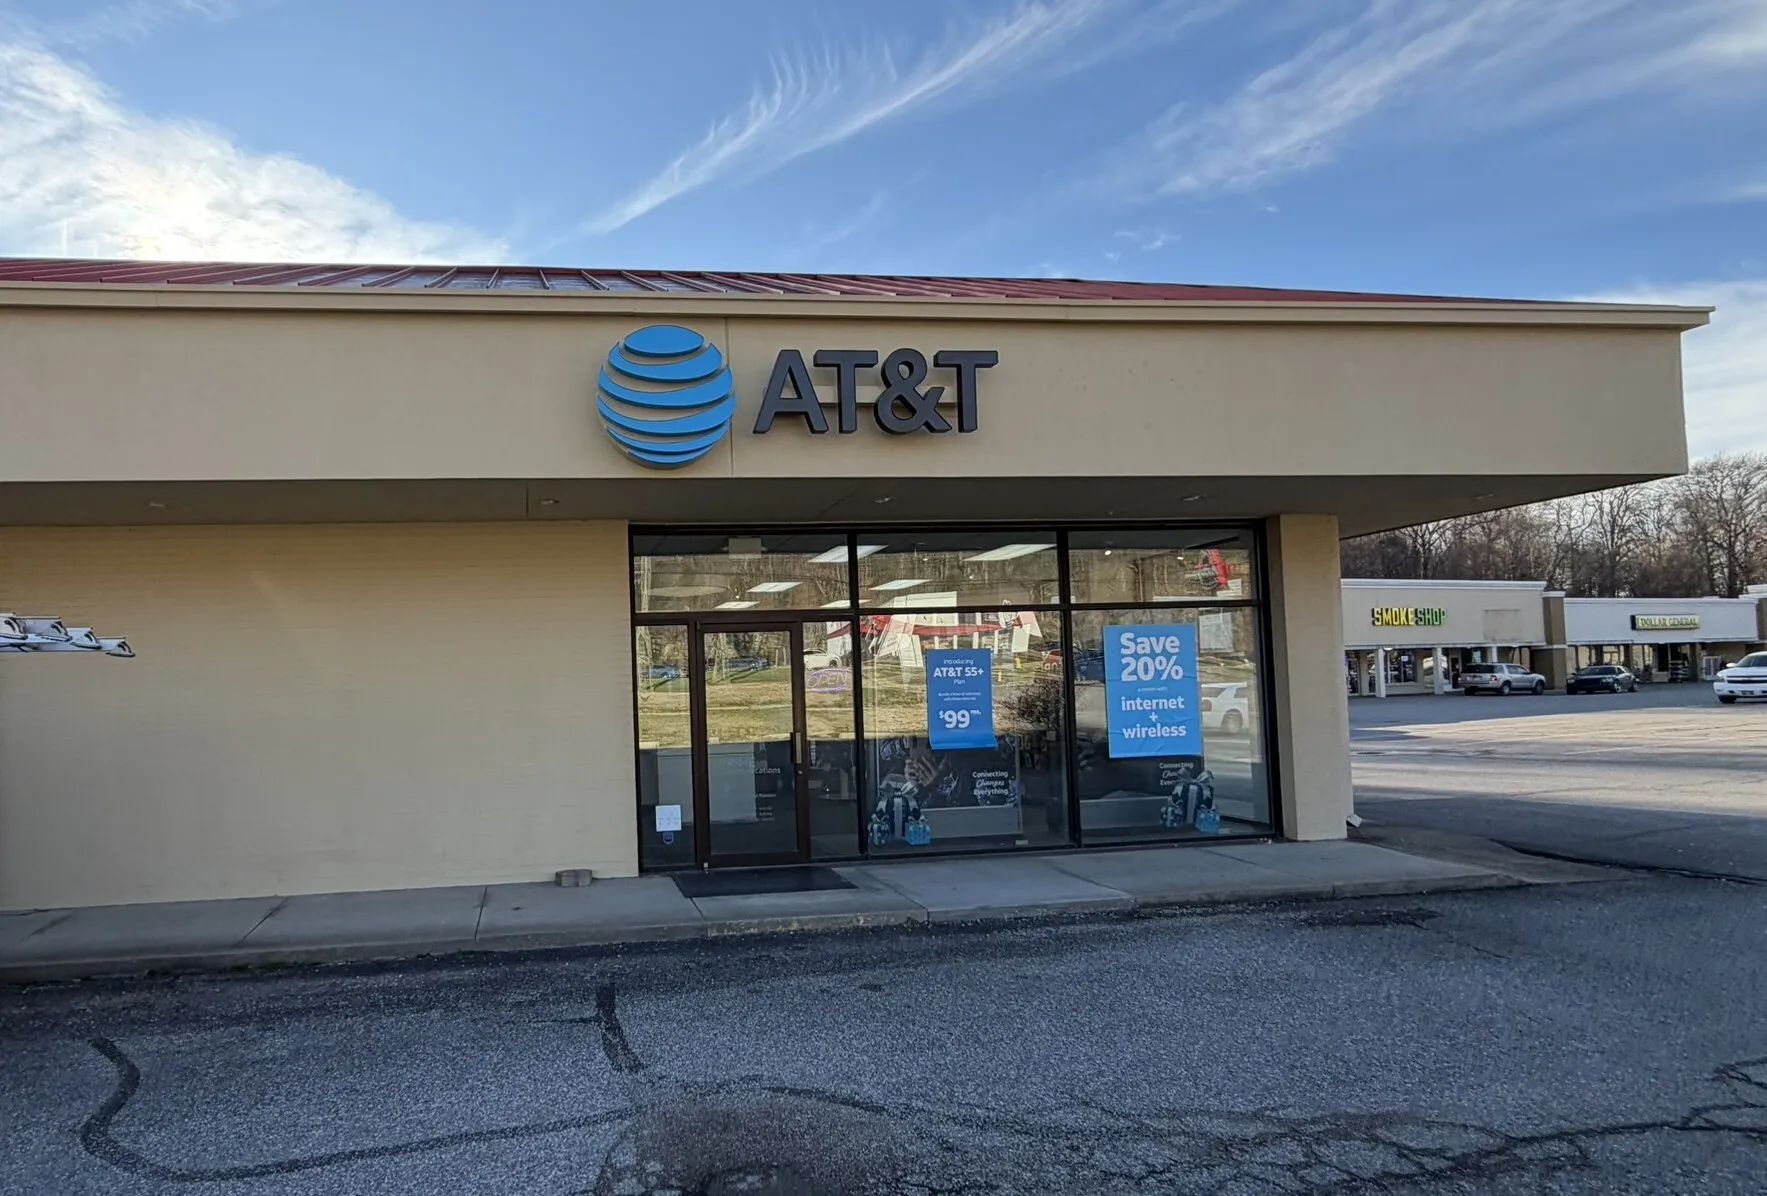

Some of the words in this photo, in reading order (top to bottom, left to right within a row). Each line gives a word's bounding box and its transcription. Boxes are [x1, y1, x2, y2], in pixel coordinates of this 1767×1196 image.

[752, 348, 999, 435] AT&T
[1371, 607, 1415, 626] SMOKE
[1415, 607, 1447, 626] SHOP
[1640, 617, 1668, 627] DOLLAR
[1669, 616, 1698, 626] GENERAL
[1120, 632, 1180, 655] Save
[943, 658, 974, 666] introducing
[1121, 655, 1184, 682] 20%
[933, 666, 963, 678] AT&T
[964, 666, 984, 677] 55+
[1121, 696, 1185, 711] internet
[1149, 711, 1159, 722] +
[1122, 722, 1187, 739] wireless
[972, 770, 1009, 779] Connecting
